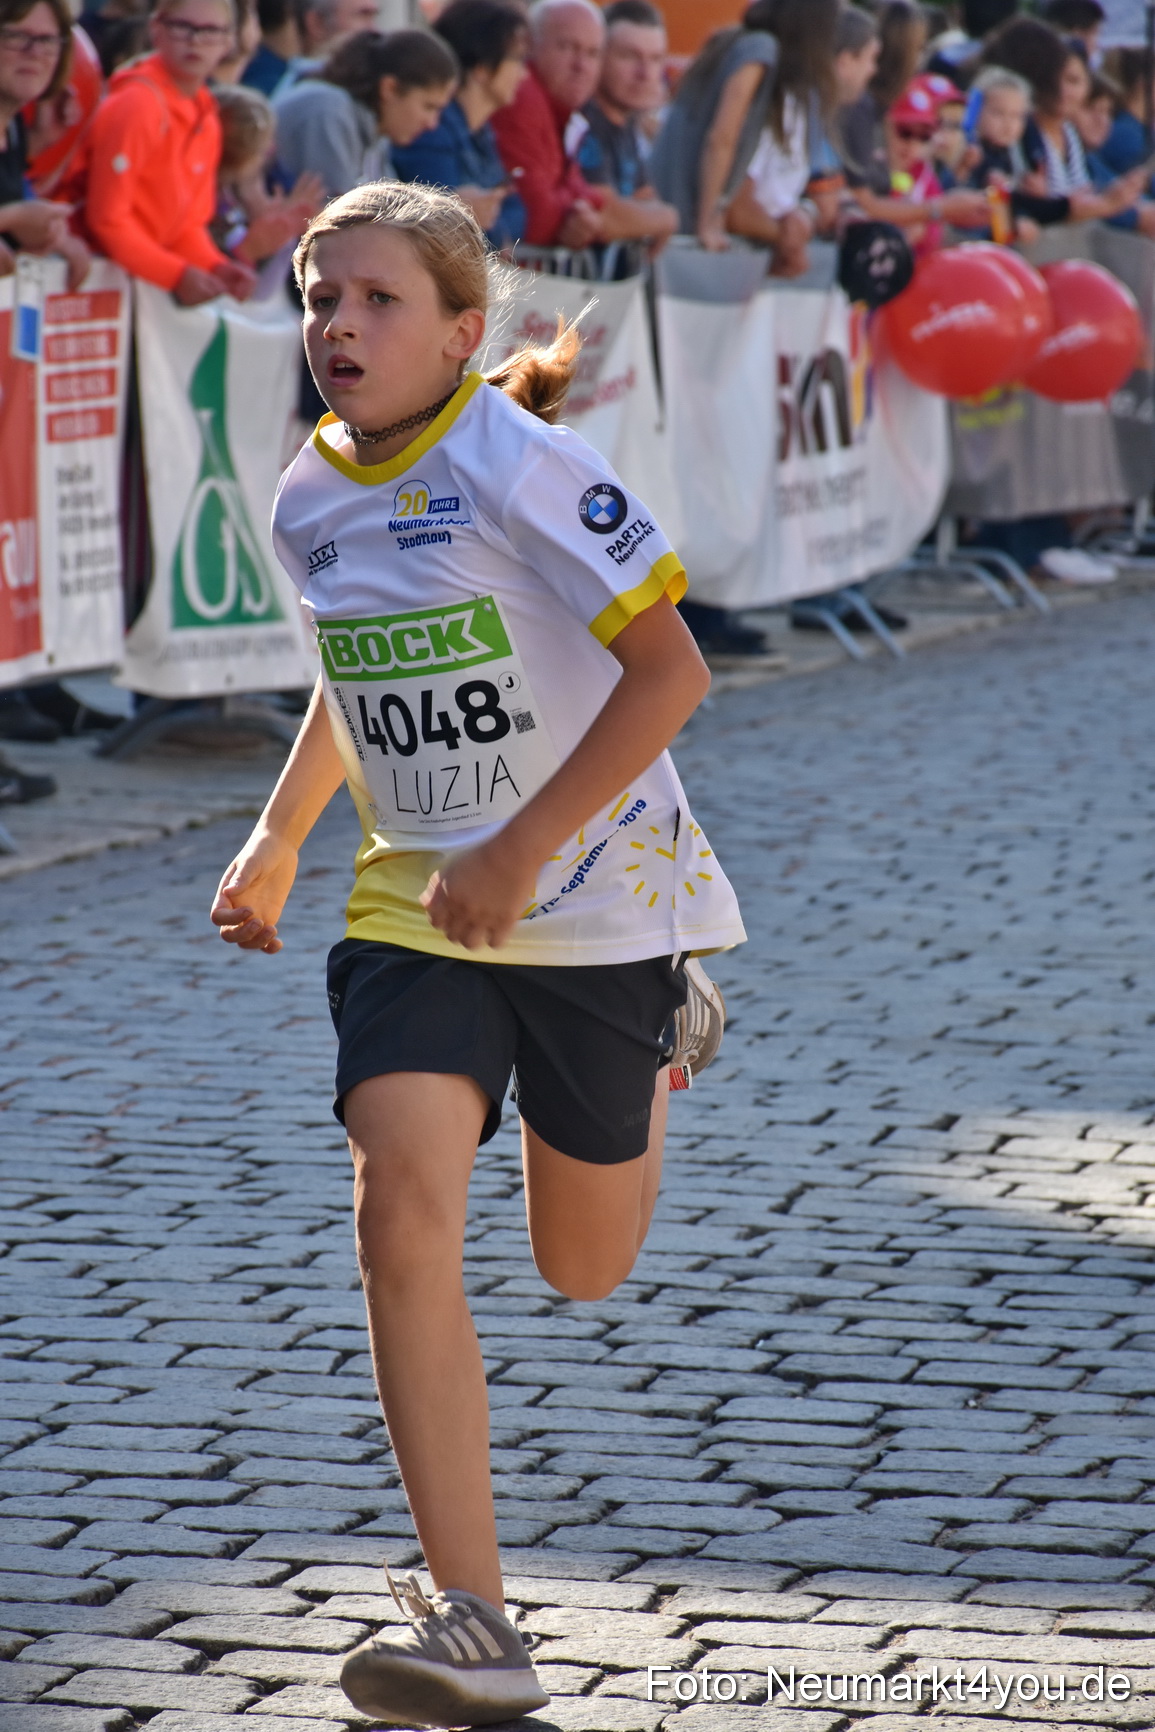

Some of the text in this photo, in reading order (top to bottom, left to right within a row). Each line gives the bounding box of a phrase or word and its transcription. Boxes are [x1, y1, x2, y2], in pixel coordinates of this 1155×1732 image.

[395, 489, 457, 517] 20 JAHRE
[580, 485, 611, 514] BMW
[605, 519, 650, 559] PARTL
[614, 525, 656, 566] Neumarkt
[324, 613, 486, 670] BOCK
[505, 676, 514, 688] J
[357, 680, 511, 757] 4048
[393, 754, 521, 815] LUZIA
[618, 799, 647, 827] 2019
